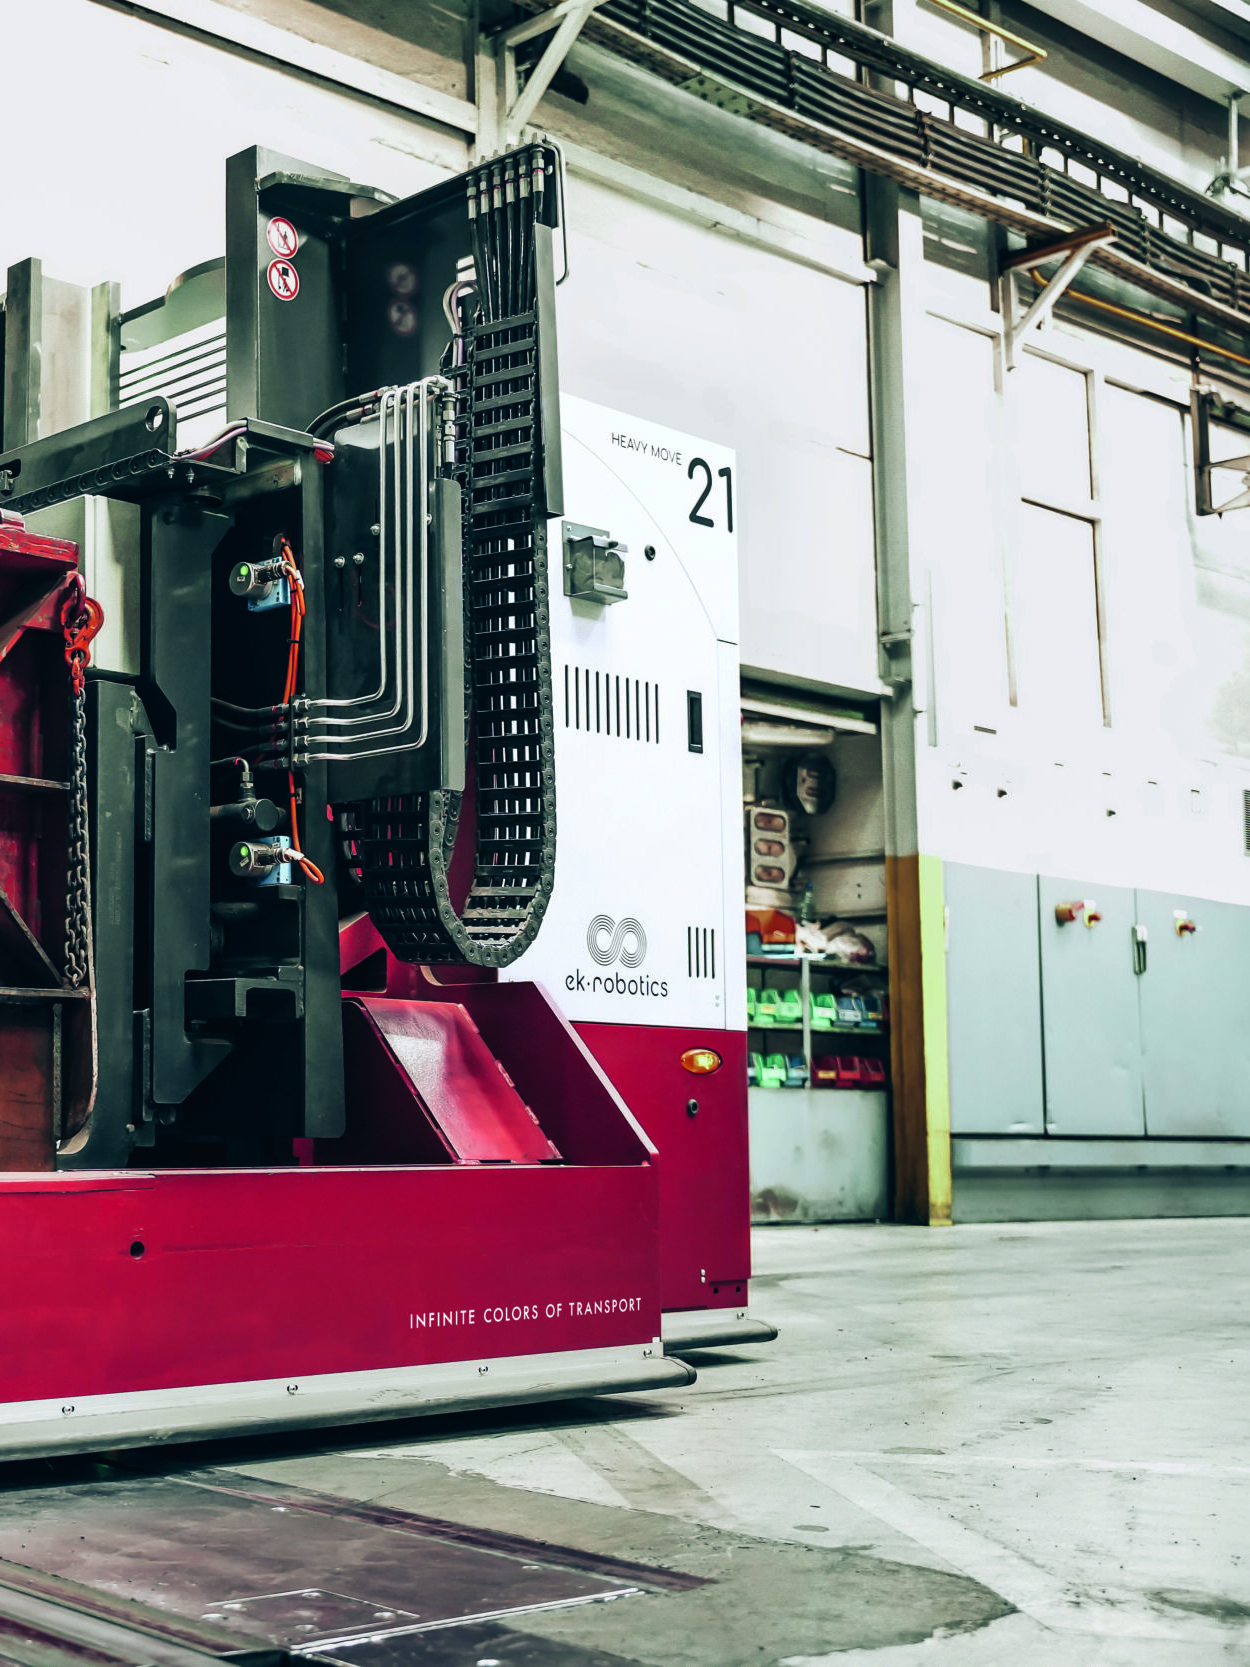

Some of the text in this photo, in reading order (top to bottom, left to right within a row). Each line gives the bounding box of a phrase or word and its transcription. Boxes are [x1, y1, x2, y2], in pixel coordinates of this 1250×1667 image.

[612, 433, 683, 466] HEAVY MOVE
[688, 457, 733, 533] 21
[410, 1298, 642, 1329] INFINITE COLORS OF TRANSPORT
